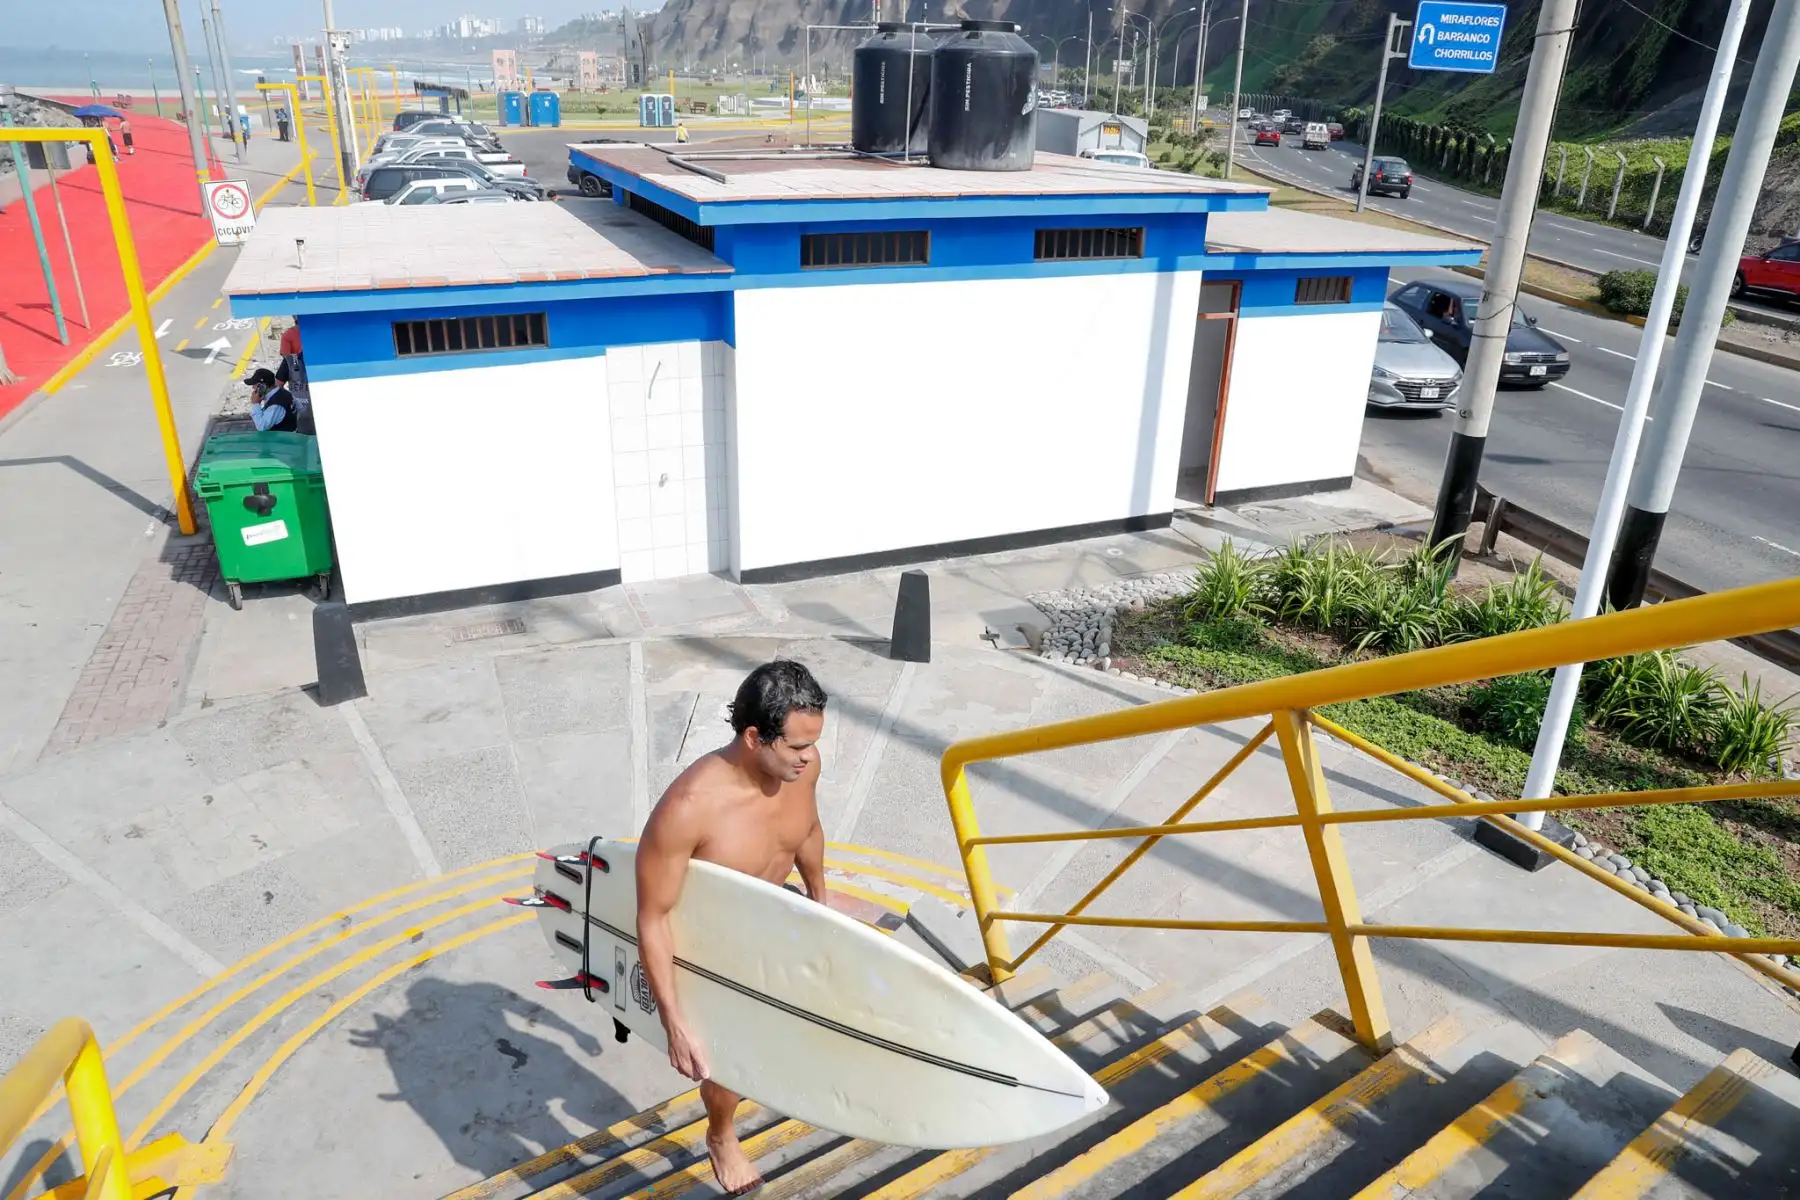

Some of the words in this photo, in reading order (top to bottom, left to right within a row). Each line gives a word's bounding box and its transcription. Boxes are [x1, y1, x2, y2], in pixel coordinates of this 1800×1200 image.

[1440, 14, 1499, 27] MIRAFLORES
[1437, 31, 1490, 43] BARRANCO
[1434, 48, 1493, 60] CHORRILLOS
